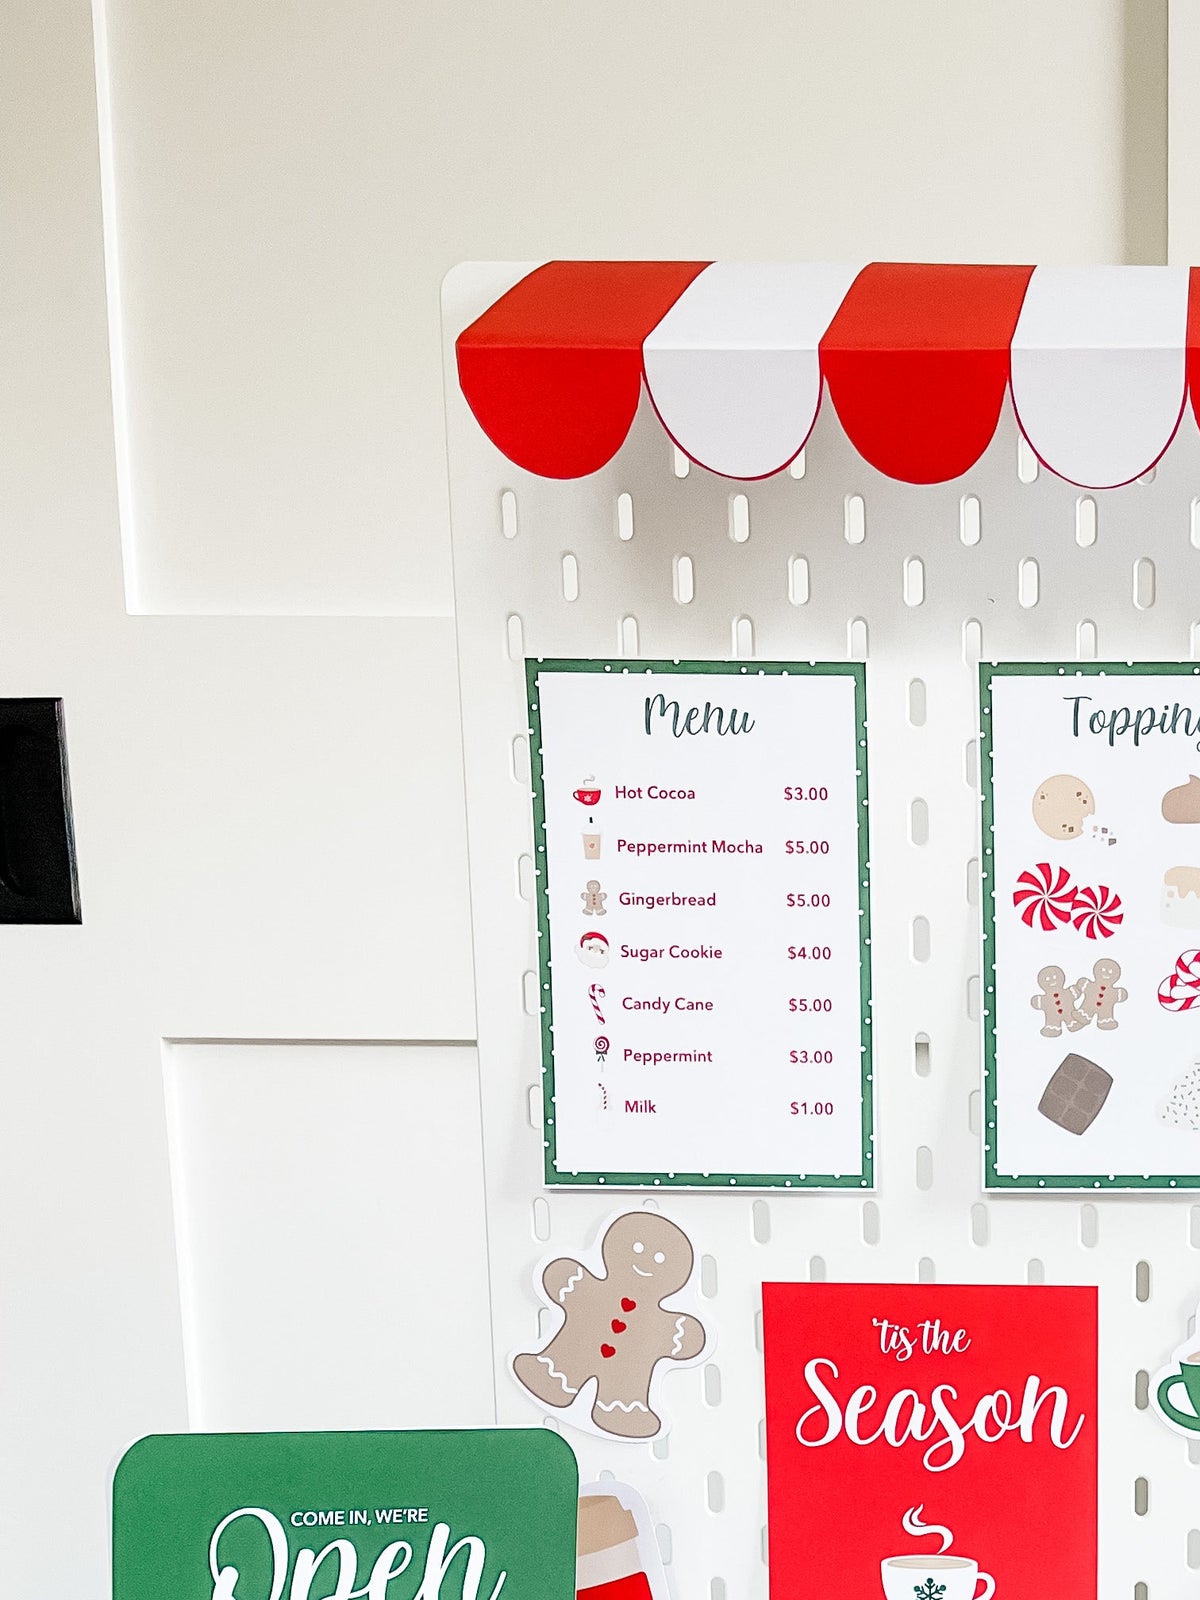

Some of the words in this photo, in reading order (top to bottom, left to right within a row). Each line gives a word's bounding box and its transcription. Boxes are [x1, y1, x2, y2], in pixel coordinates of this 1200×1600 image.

[644, 693, 756, 738] Menu
[615, 785, 643, 800] Hot
[647, 785, 696, 800] Cocoa
[783, 786, 829, 801] $3.00
[617, 838, 708, 857] Peppermint
[711, 839, 763, 854] Mocha
[785, 839, 830, 855] $5.00
[618, 891, 717, 910] Gingerbread
[786, 892, 831, 908] $5.00
[620, 944, 665, 962] Sugar
[668, 944, 723, 959] Cookie
[787, 945, 832, 961] $4.00
[621, 995, 671, 1015] Candy
[674, 996, 714, 1011] Cane
[788, 997, 833, 1013] $5.00
[623, 1048, 713, 1067] Peppermint
[789, 1049, 834, 1064] $3.00
[624, 1099, 657, 1114] Milk
[790, 1101, 834, 1116] $1.00
[916, 1318, 972, 1355] the
[795, 1357, 1086, 1473] Season
[290, 1510, 345, 1527] COME
[349, 1509, 372, 1527] IN,
[375, 1508, 429, 1523] WE'RE
